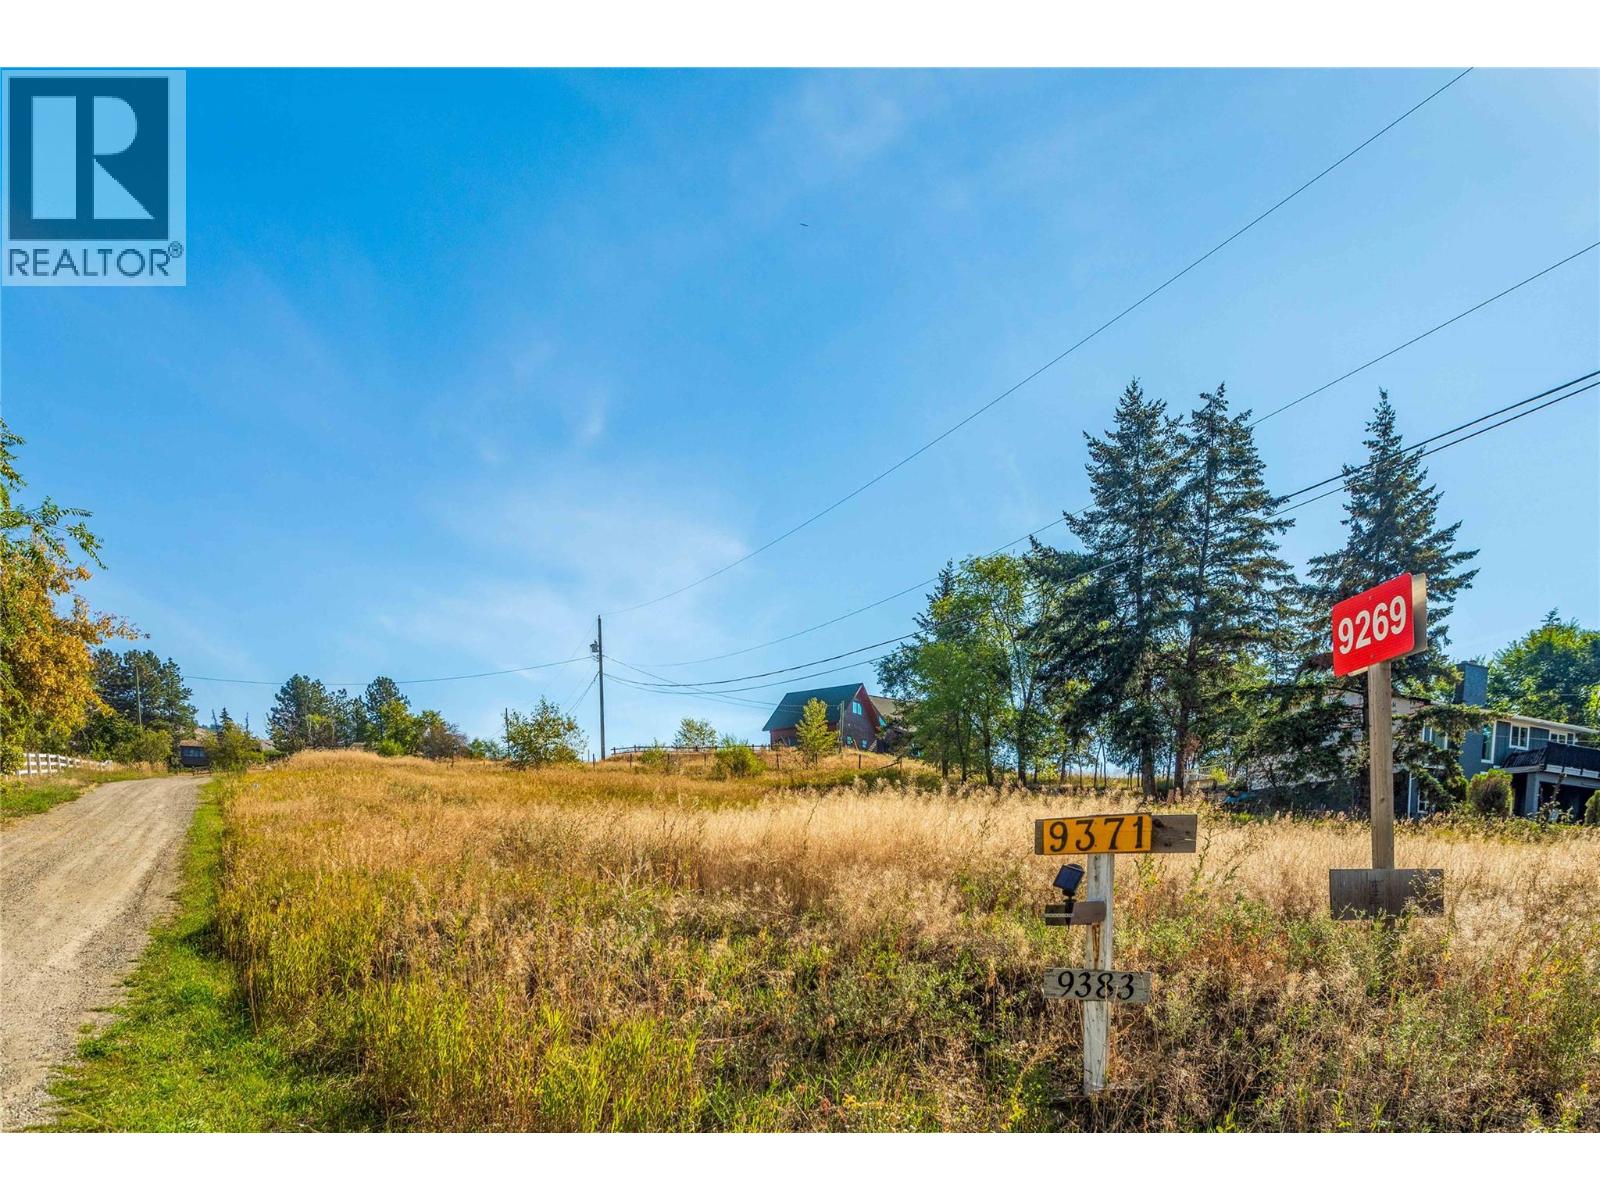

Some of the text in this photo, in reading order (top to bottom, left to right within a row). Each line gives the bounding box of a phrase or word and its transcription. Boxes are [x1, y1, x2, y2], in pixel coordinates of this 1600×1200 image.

[1338, 595, 1407, 655] 9269
[1049, 816, 1144, 852] 9371
[1058, 970, 1135, 1001] 9383
